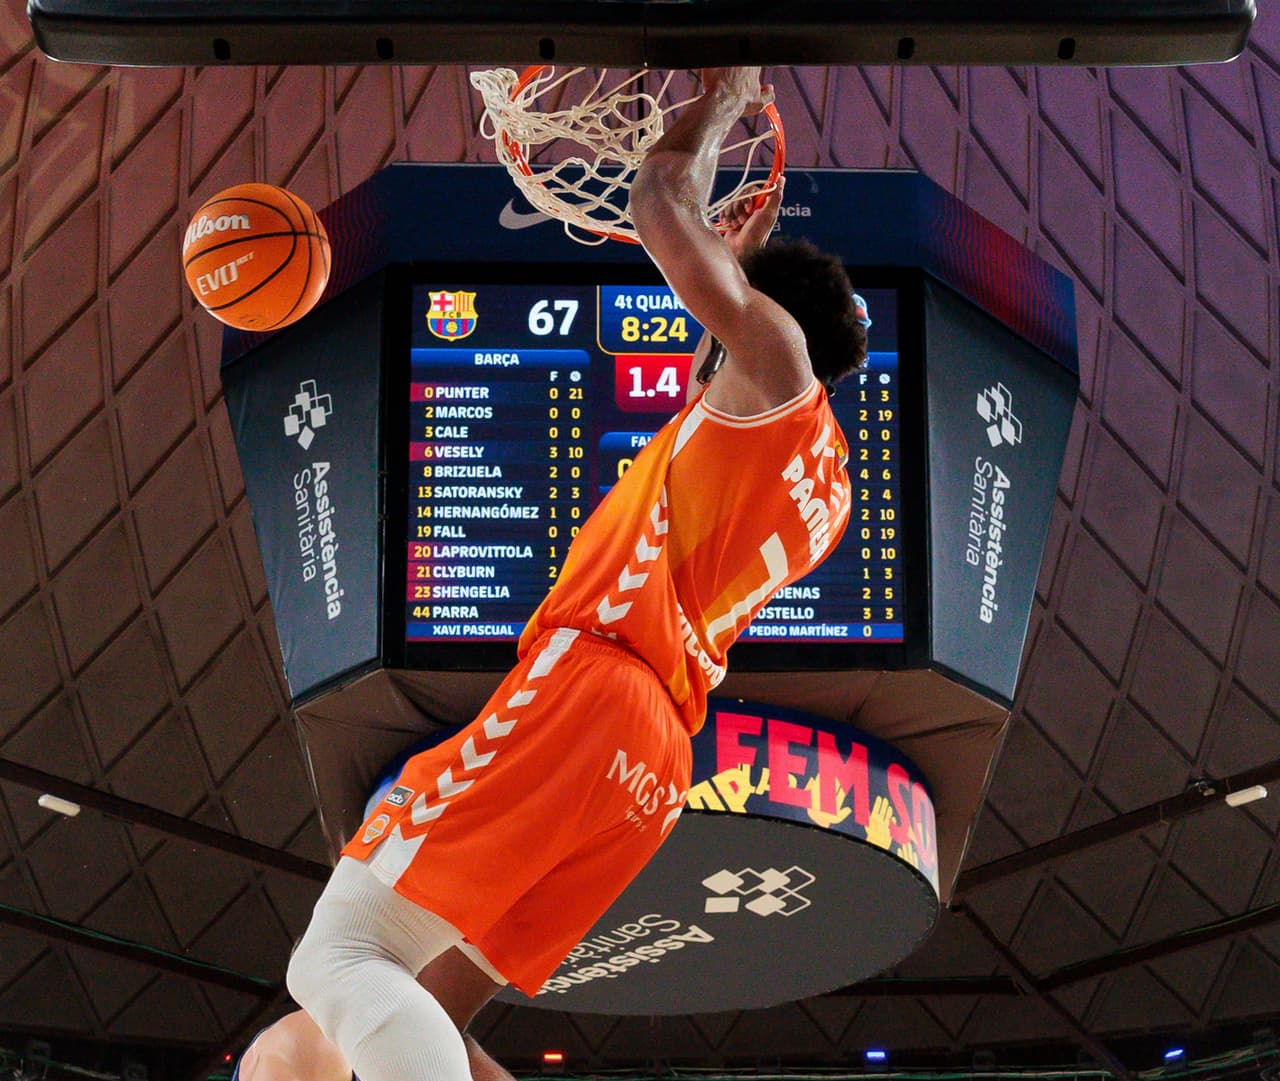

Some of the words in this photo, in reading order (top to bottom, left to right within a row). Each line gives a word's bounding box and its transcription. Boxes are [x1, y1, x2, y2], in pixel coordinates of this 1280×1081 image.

[195, 261, 239, 296] EVO
[614, 295, 632, 309] 4t
[528, 299, 580, 336] 67
[621, 316, 689, 342] 8:24
[474, 353, 520, 367] BARÇA
[549, 371, 559, 382] F
[628, 366, 681, 398] 1.4
[859, 374, 868, 385] F
[424, 388, 434, 398] 0
[435, 387, 490, 398] PUNTER
[549, 388, 559, 399] 0
[569, 388, 583, 400] 21
[859, 391, 867, 401] 1
[881, 391, 889, 402] 3
[425, 407, 434, 418] 2
[435, 407, 493, 419] MARCOS
[549, 408, 559, 419] 0
[571, 408, 581, 419] 0
[859, 410, 868, 421] 2
[878, 410, 893, 421] 19
[425, 427, 433, 438] 3
[435, 427, 468, 438] CALE
[549, 427, 559, 438] 0
[571, 427, 581, 438] 0
[859, 429, 868, 440] 0
[881, 429, 891, 441] 0
[424, 446, 433, 457] 6
[434, 446, 485, 458] VESELY
[549, 447, 558, 458] 3
[569, 447, 584, 458] 10
[860, 449, 868, 460] 2
[881, 449, 890, 460] 2
[423, 466, 432, 477] 8
[434, 466, 502, 478] BRIZUELA
[549, 467, 558, 478] 2
[571, 467, 580, 478] 0
[860, 469, 869, 480] 4
[882, 469, 891, 480] 6
[418, 486, 432, 498] 13
[434, 486, 523, 499] SATORANSKY
[549, 487, 557, 498] 2
[571, 487, 580, 499] 3
[861, 489, 870, 500] 2
[882, 489, 892, 500] 4
[417, 506, 431, 518] 14
[434, 504, 539, 519] HERNANGÓMEZ
[550, 507, 557, 518] 1
[571, 507, 580, 518] 0
[861, 509, 870, 520] 2
[880, 509, 895, 520] 10
[966, 456, 994, 567] Sanitària
[293, 468, 320, 582] Sanitària
[417, 526, 431, 537] 19
[434, 526, 466, 538] FALL
[548, 526, 558, 538] 0
[861, 528, 870, 539] 0
[880, 528, 895, 539] 19
[311, 461, 345, 621] Assistència
[979, 464, 1011, 625] Assistència
[414, 546, 431, 557] 20
[433, 546, 533, 558] LAPROVITTOLA
[550, 546, 556, 558] 1
[862, 548, 871, 559] 0
[881, 548, 896, 559] 10
[417, 566, 431, 578] 21
[433, 566, 495, 578] CLYBURN
[548, 566, 557, 578] 2
[863, 568, 870, 579] 1
[884, 568, 893, 579] 3
[415, 586, 431, 598] 23
[433, 586, 510, 598] SHENGELIA
[862, 588, 871, 599] 2
[884, 588, 894, 599] 5
[413, 606, 430, 618] 44
[433, 606, 479, 618] PARRA
[754, 607, 814, 620] OSTELLO
[863, 608, 871, 619] 3
[885, 608, 894, 620] 3
[433, 625, 461, 635] XAVI
[463, 625, 514, 635] PASCUAL
[749, 626, 787, 636] PEDRO
[789, 623, 848, 637] MARTÍNEZ
[863, 626, 872, 637] 0
[715, 711, 871, 828] FEM
[605, 749, 666, 816] MGS
